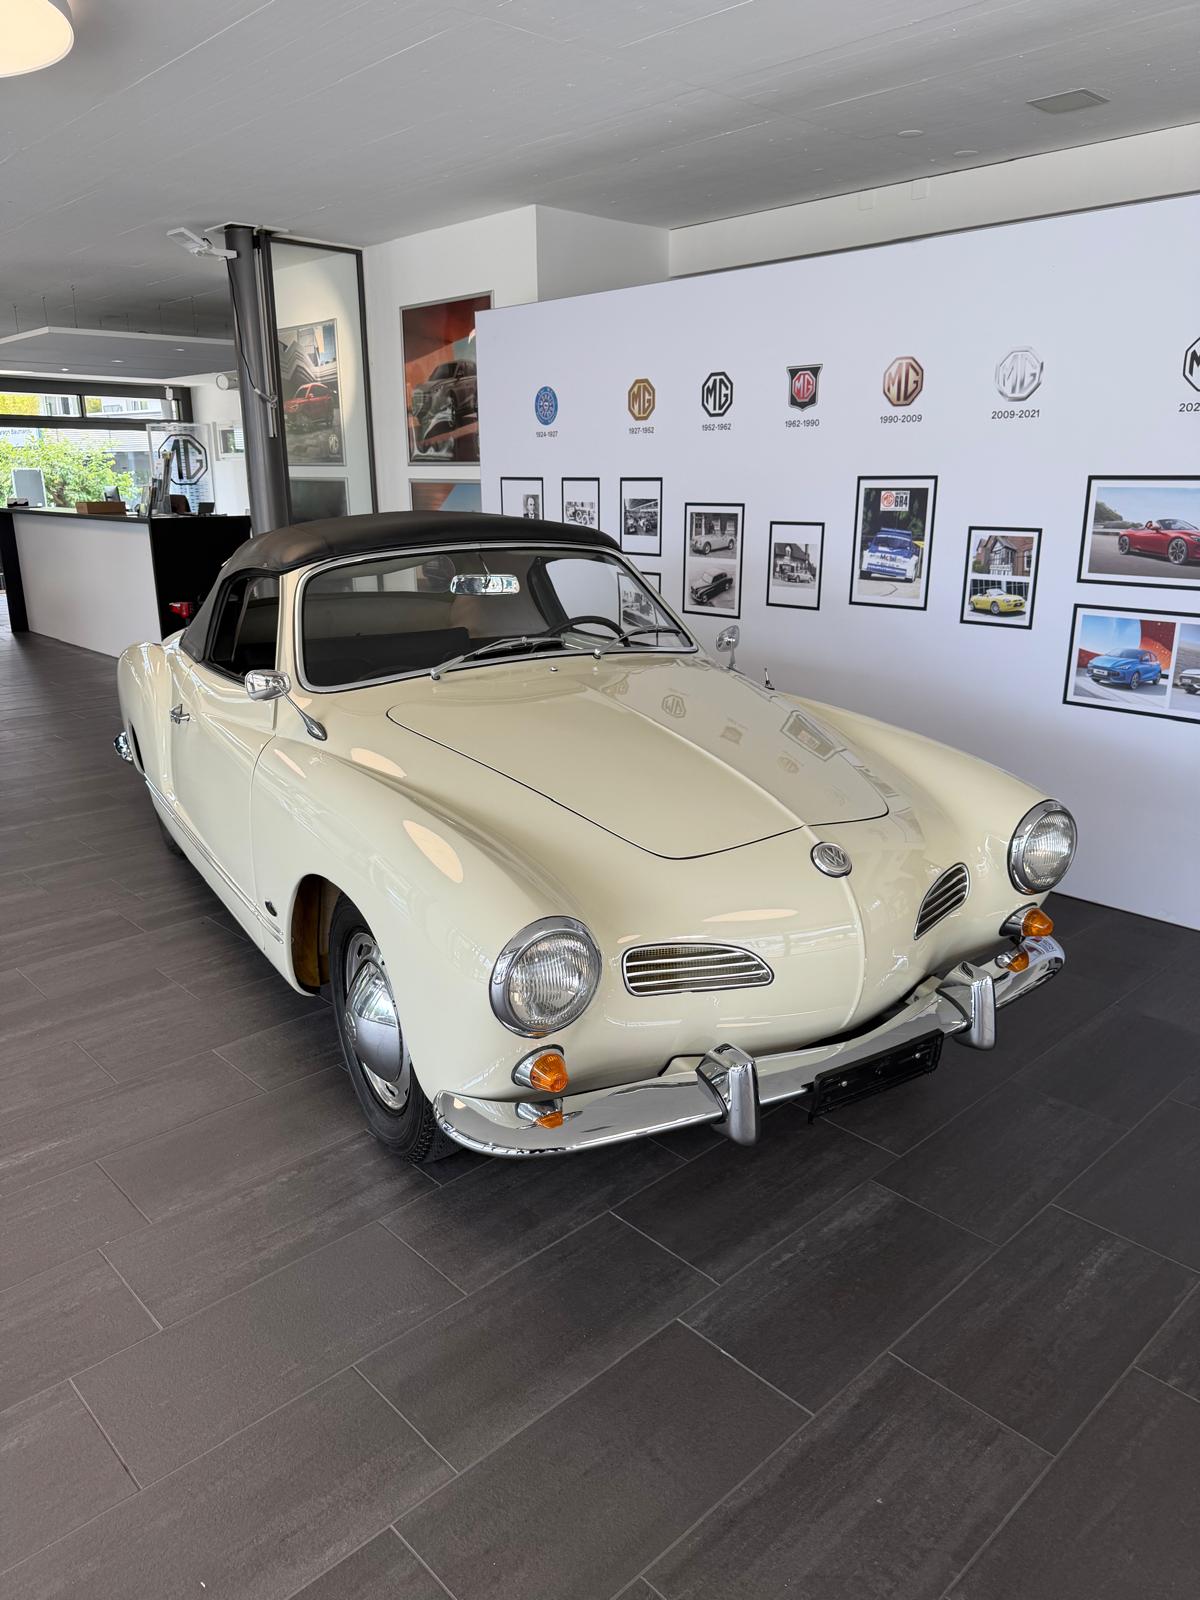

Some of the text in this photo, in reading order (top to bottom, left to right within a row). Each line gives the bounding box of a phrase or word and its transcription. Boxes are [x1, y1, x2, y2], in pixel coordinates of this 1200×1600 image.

[887, 362, 920, 402] MG
[1002, 354, 1037, 393] MG
[631, 383, 653, 417] MG
[705, 377, 730, 412] MG
[784, 419, 820, 428] 1962-1990
[879, 414, 923, 424] 1990-2009
[991, 409, 1040, 419] 2009-2021
[701, 423, 732, 432] 1952-1962
